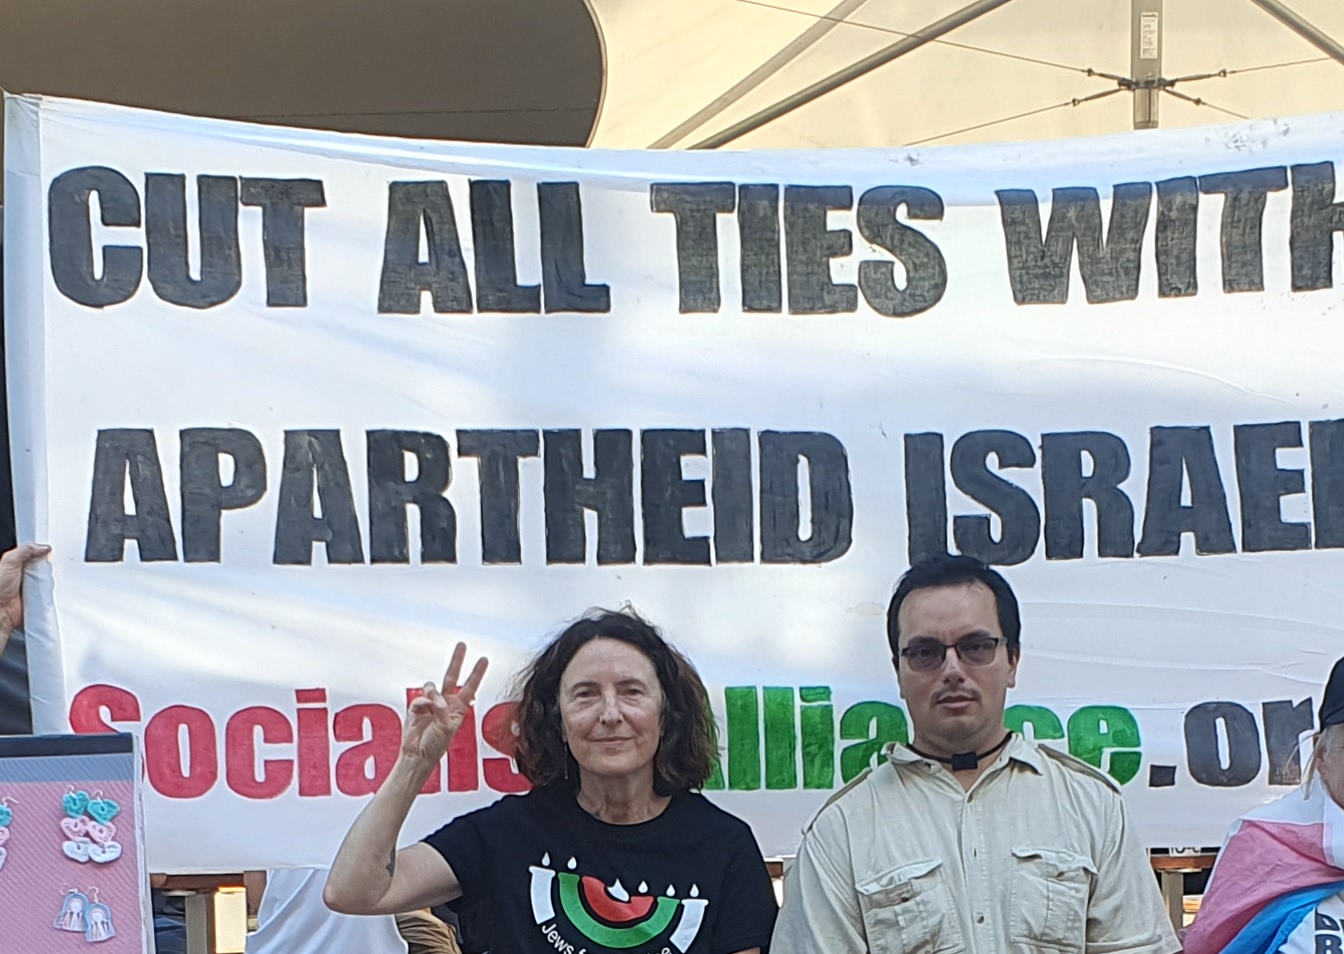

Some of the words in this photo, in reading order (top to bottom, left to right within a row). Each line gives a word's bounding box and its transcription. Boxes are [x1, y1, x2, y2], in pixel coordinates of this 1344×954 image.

[49, 165, 327, 310] CUT
[377, 179, 612, 314] ALL
[650, 182, 948, 318] TIES
[84, 427, 855, 567] APARTHEID
